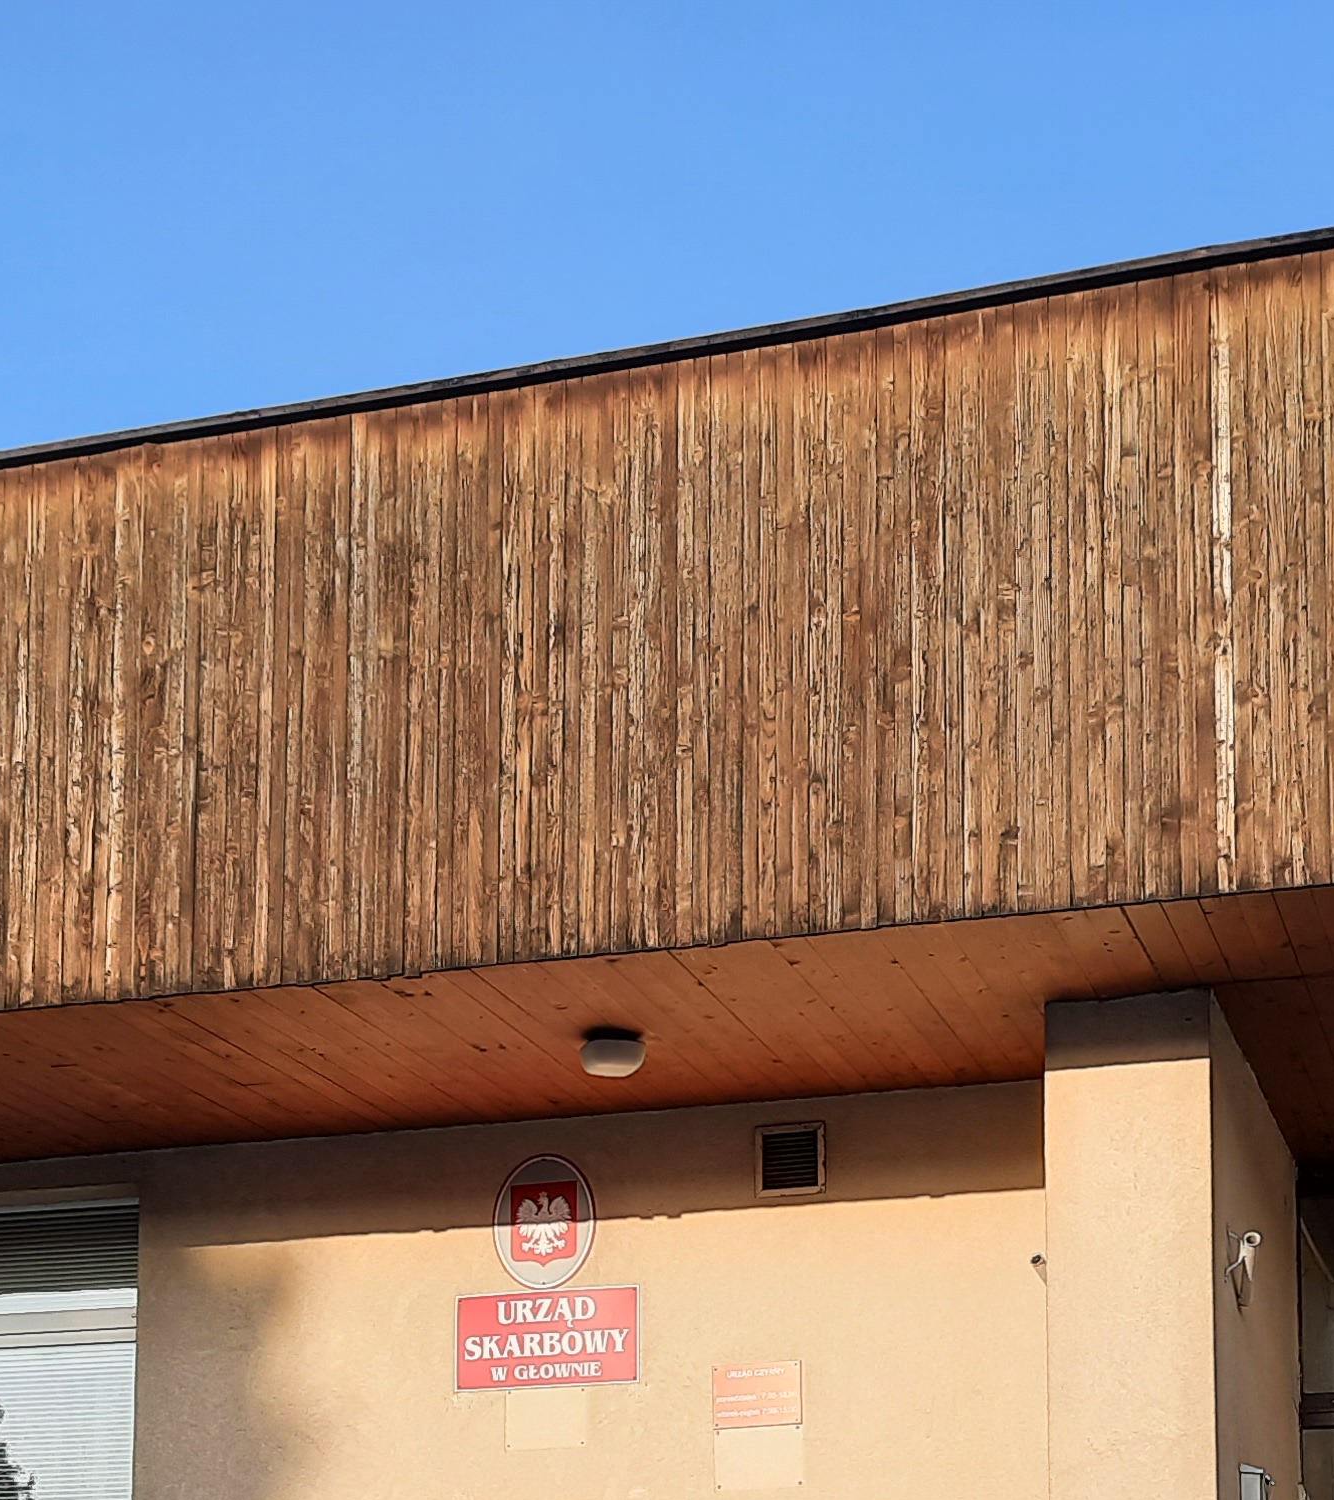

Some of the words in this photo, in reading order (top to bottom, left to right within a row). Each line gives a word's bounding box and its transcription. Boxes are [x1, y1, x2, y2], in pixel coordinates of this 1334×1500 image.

[496, 1295, 596, 1328] URZĄD
[463, 1327, 630, 1362] SKARBOWY
[490, 1365, 510, 1382] W
[513, 1361, 602, 1381] GŁOWNIE
